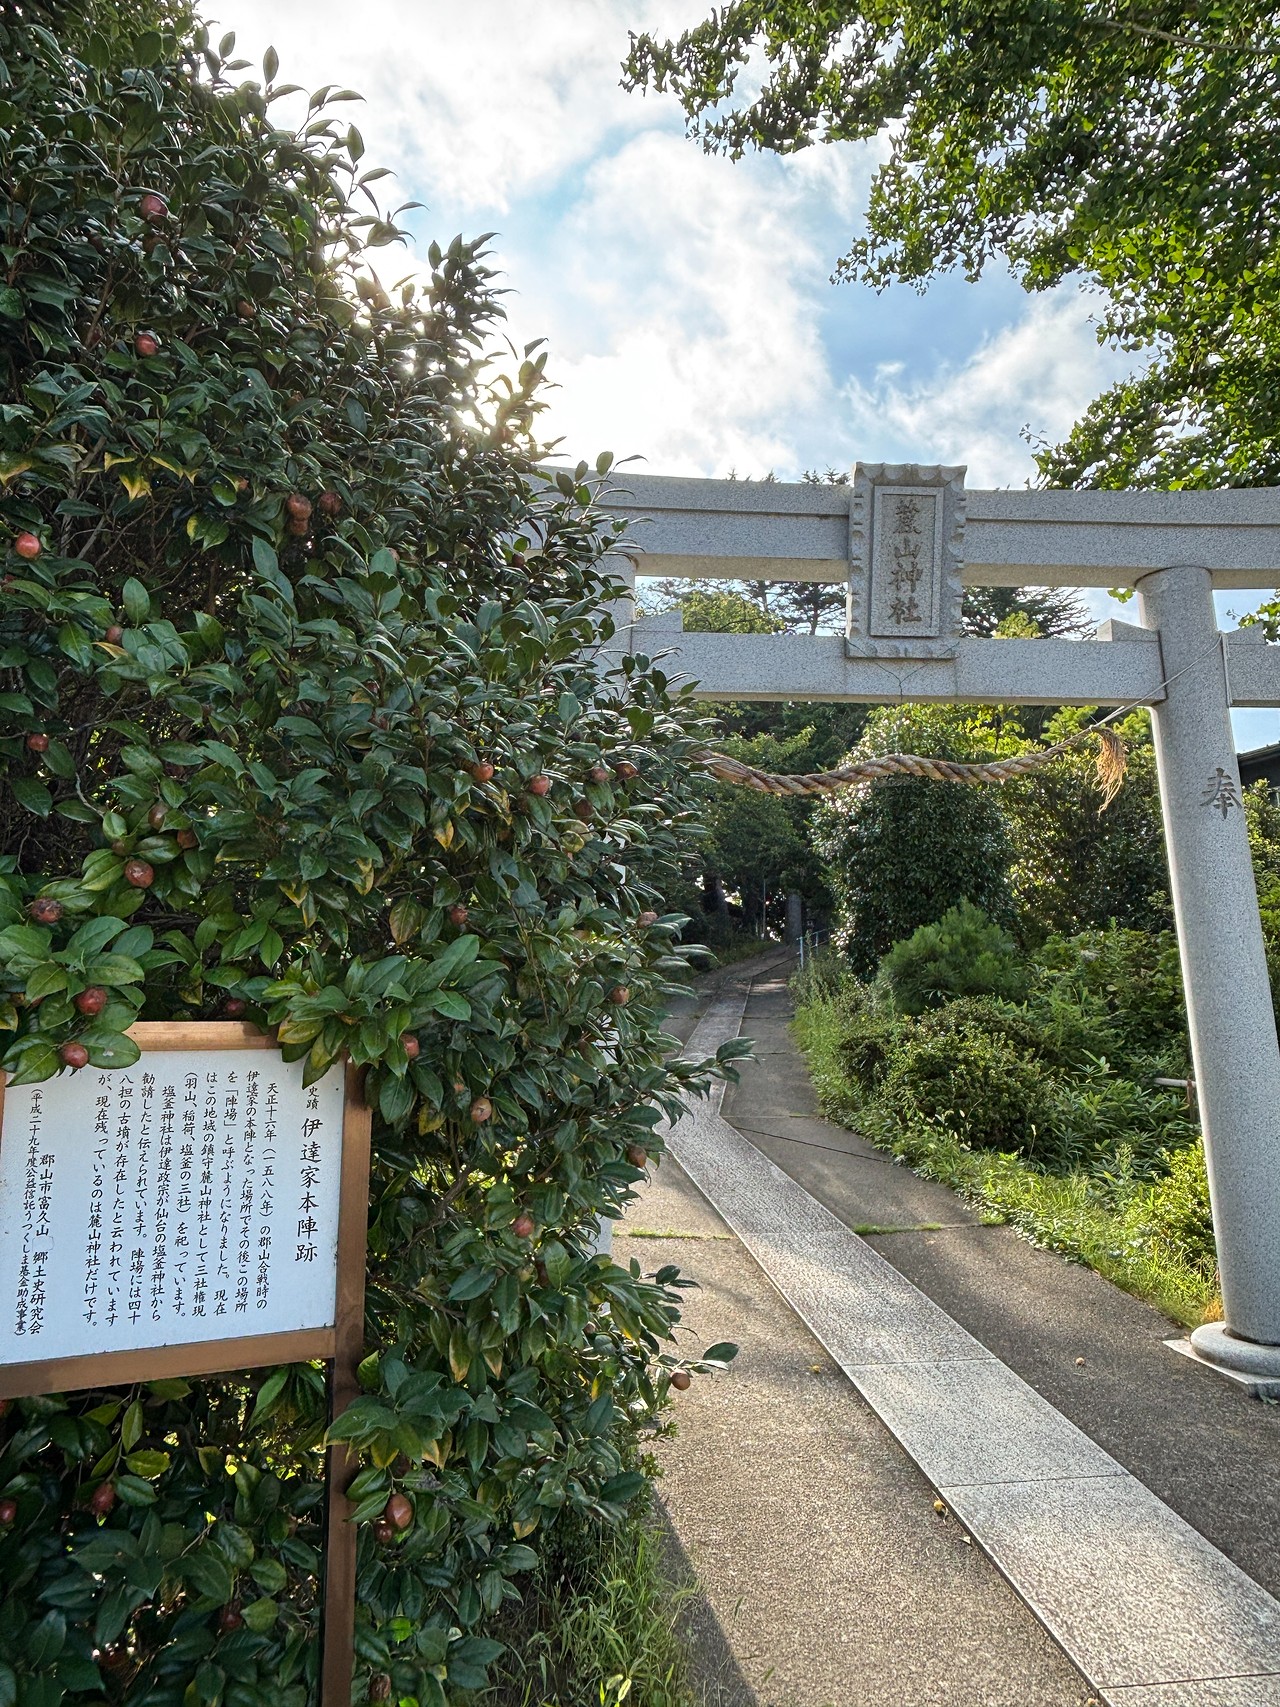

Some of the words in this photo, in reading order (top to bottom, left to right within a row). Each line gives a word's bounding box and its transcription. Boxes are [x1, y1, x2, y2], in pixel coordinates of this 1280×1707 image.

[1192, 767, 1220, 819] 奉
[306, 1084, 319, 1110] 史蹟
[295, 1118, 323, 1262] 伊達家本陣跡
[28, 1252, 48, 1334] 郷土史研究会
